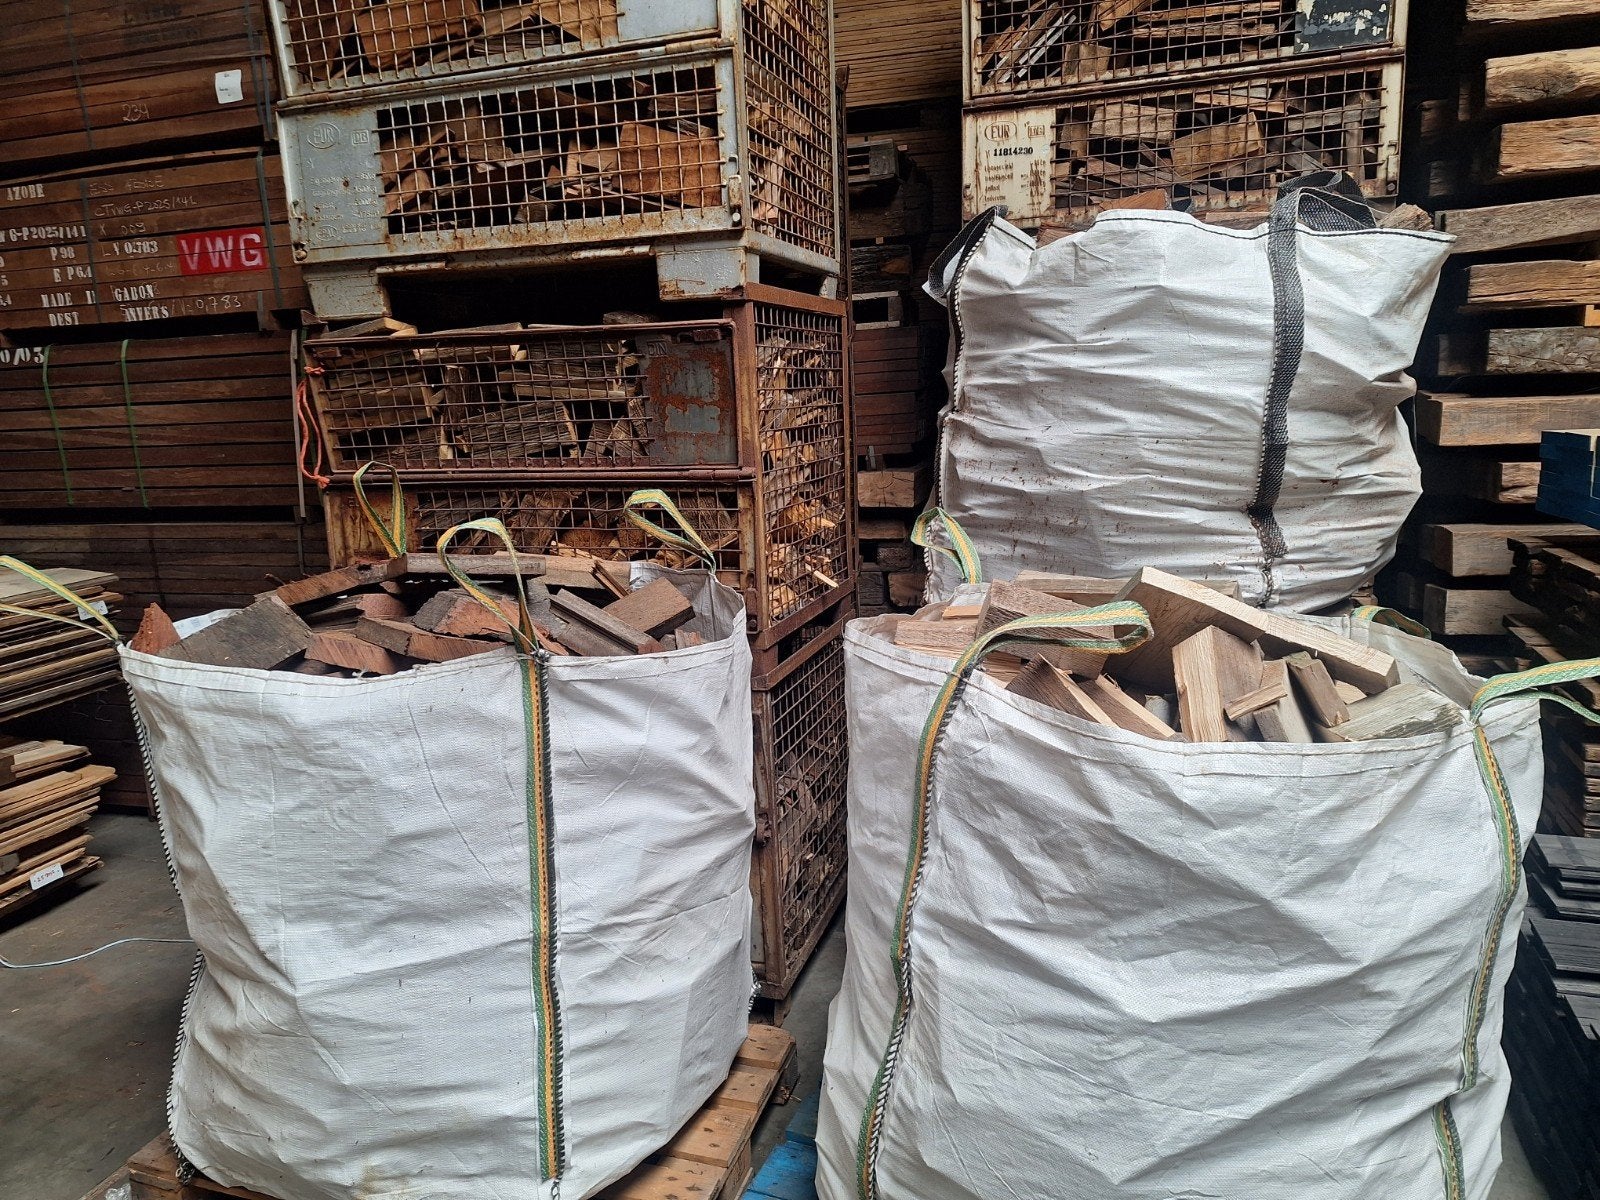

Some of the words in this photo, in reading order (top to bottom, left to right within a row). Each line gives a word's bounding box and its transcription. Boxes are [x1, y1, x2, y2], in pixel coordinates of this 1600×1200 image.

[991, 125, 1010, 139] EUR
[993, 146, 1033, 157] 11814230
[180, 232, 264, 271] VWG
[40, 292, 73, 308] MADE
[114, 284, 155, 302] GABON
[48, 311, 80, 327] DEST
